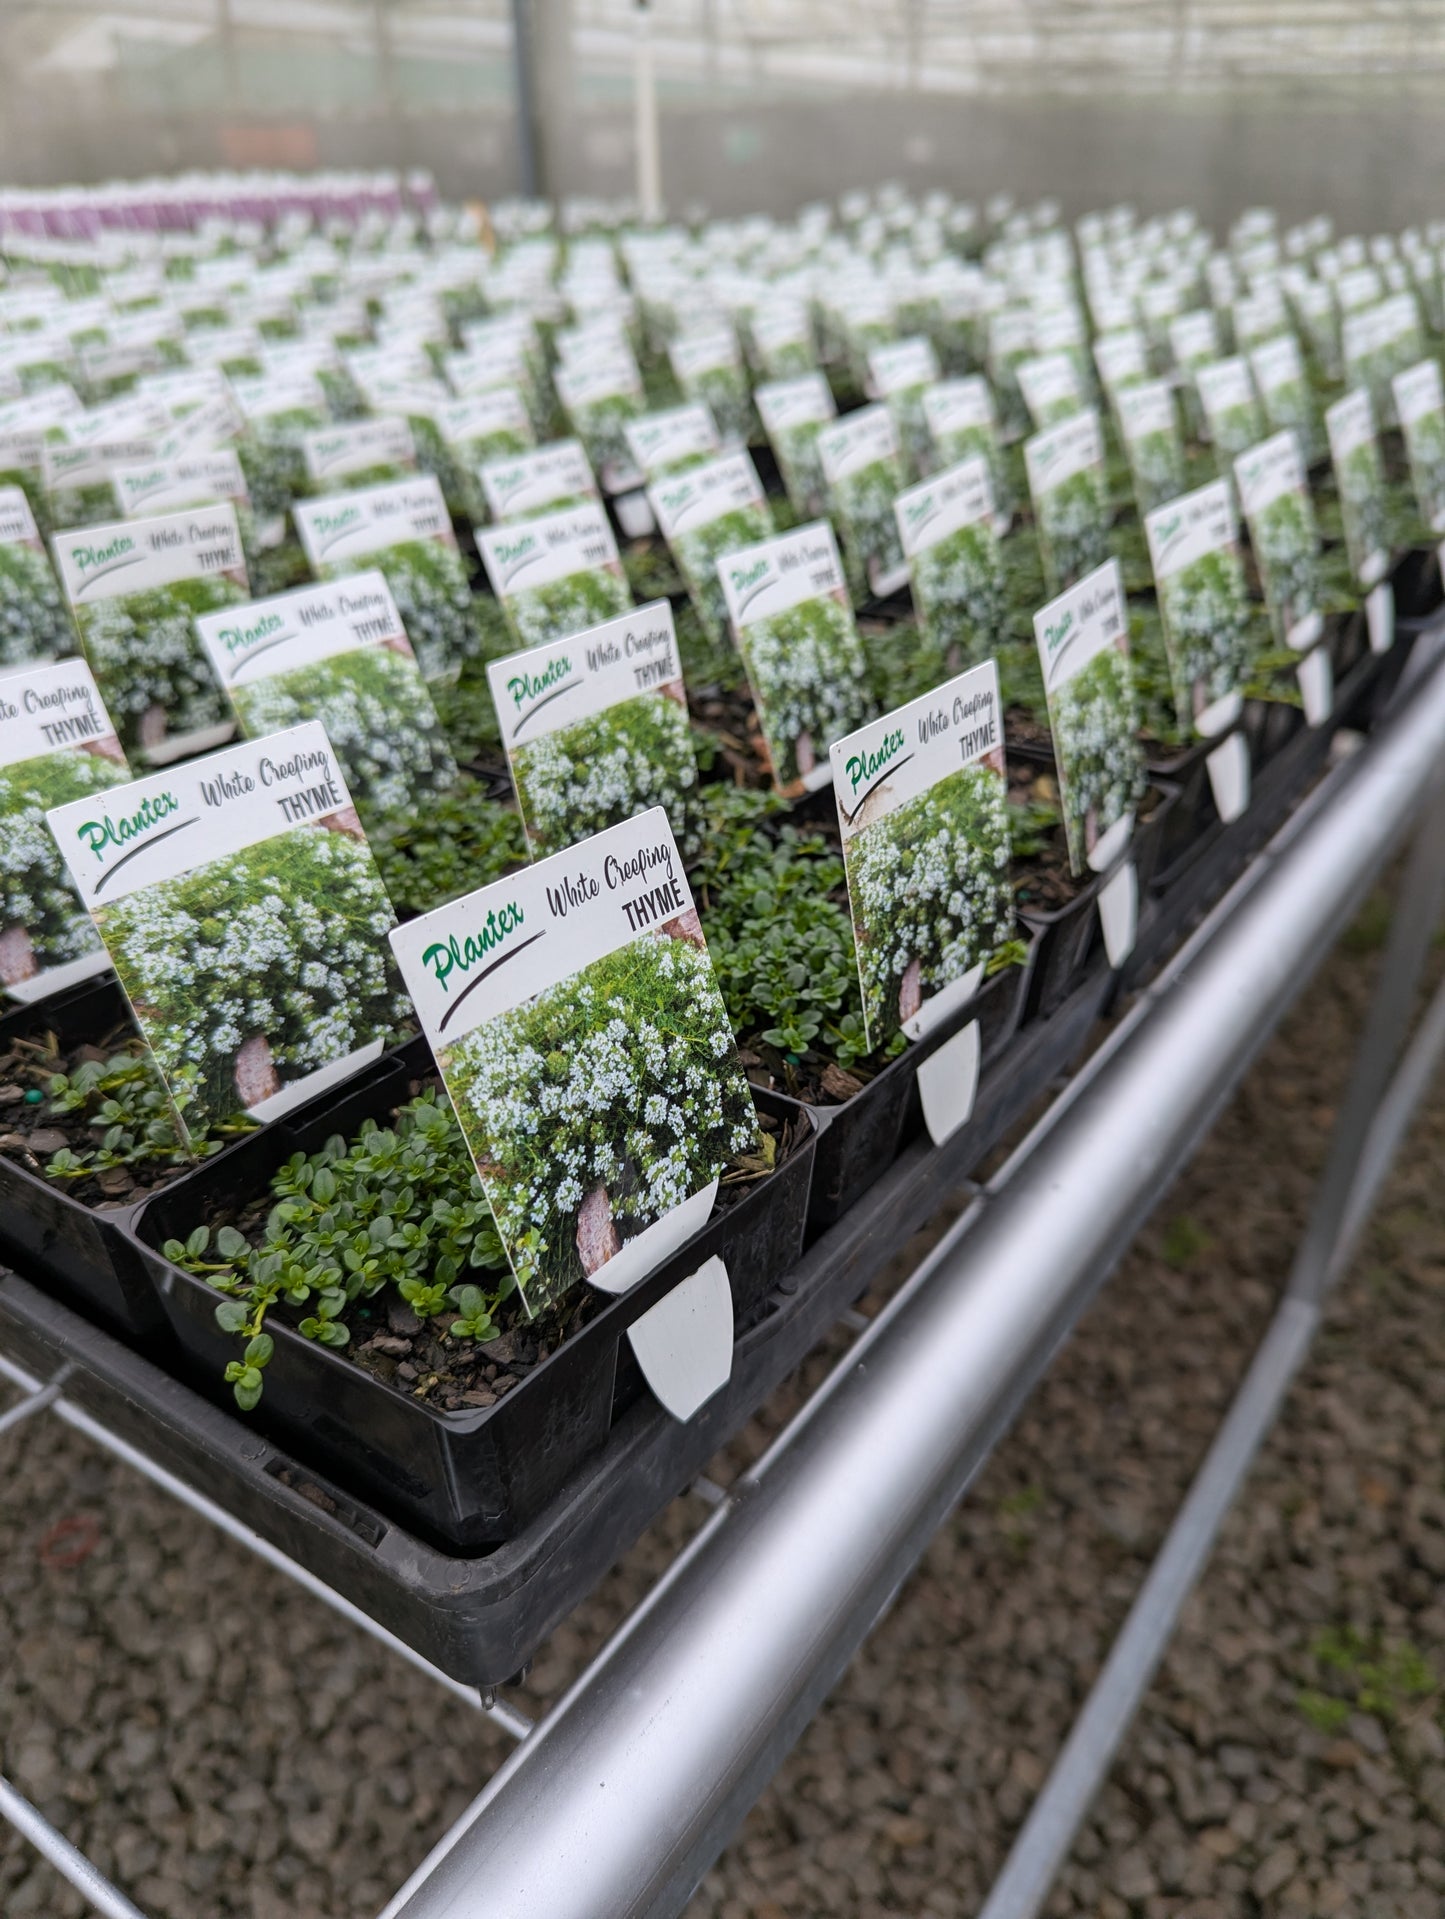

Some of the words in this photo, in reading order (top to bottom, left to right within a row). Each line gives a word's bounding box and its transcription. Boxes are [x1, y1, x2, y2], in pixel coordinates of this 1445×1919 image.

[507, 656, 572, 712] Plantex
[586, 643, 622, 672] White
[633, 656, 676, 689] THYME
[23, 686, 94, 714] Creeping
[918, 709, 949, 744] White
[952, 691, 993, 725] Creeping
[40, 712, 105, 746] THYME
[959, 720, 996, 761] THYME
[200, 771, 255, 807] White
[259, 750, 329, 787] Creeping
[846, 728, 904, 796] Plantex
[77, 791, 179, 862] Plantex
[277, 779, 344, 823] THYME
[546, 872, 600, 917] White
[604, 843, 672, 891] Creeping
[621, 878, 685, 932] THYME
[421, 901, 525, 992] Plantex
